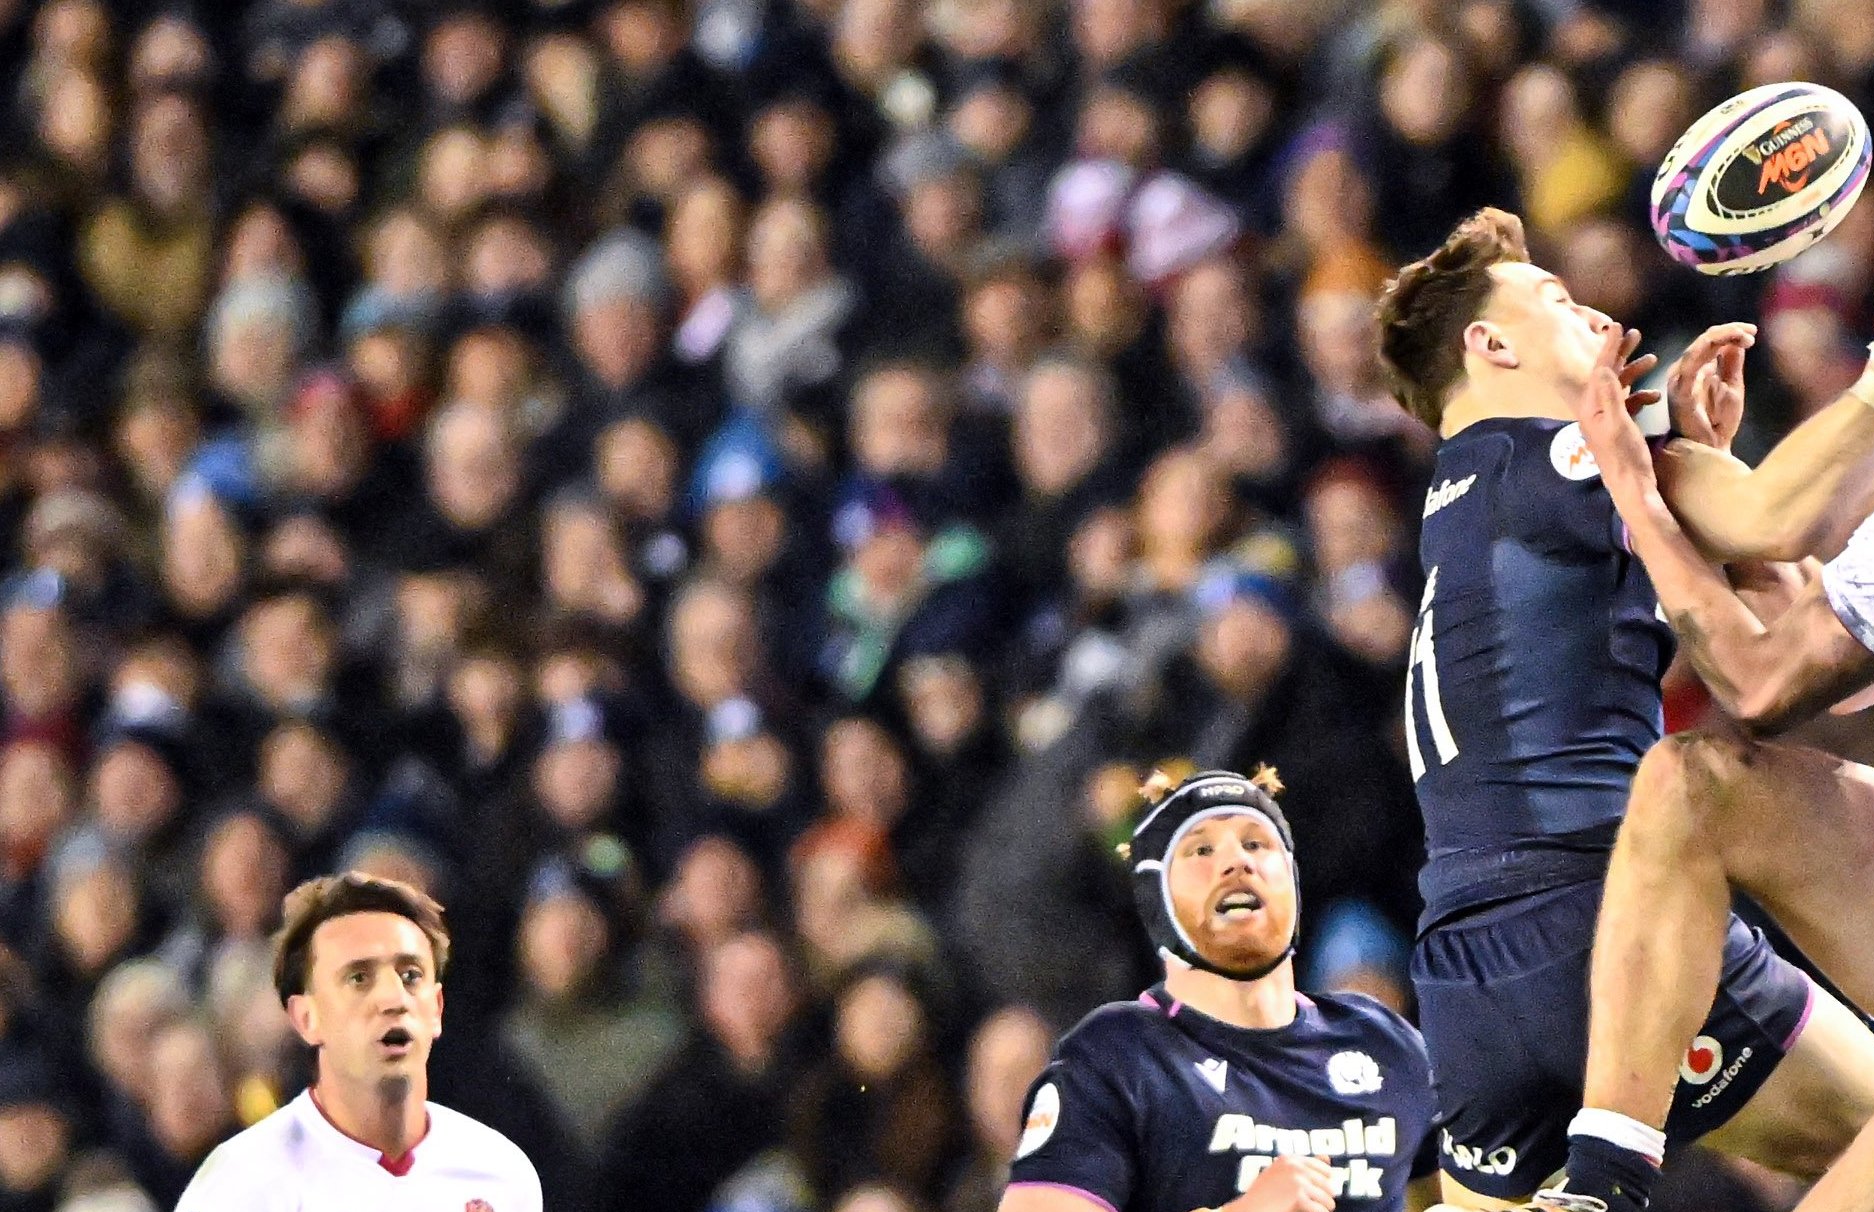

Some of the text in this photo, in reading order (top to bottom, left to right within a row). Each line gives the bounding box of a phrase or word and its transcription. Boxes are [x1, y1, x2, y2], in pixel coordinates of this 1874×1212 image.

[1691, 1046, 1754, 1109] vodafone
[1208, 1113, 1397, 1156] Arnold
[1236, 1155, 1385, 1198] Crk
